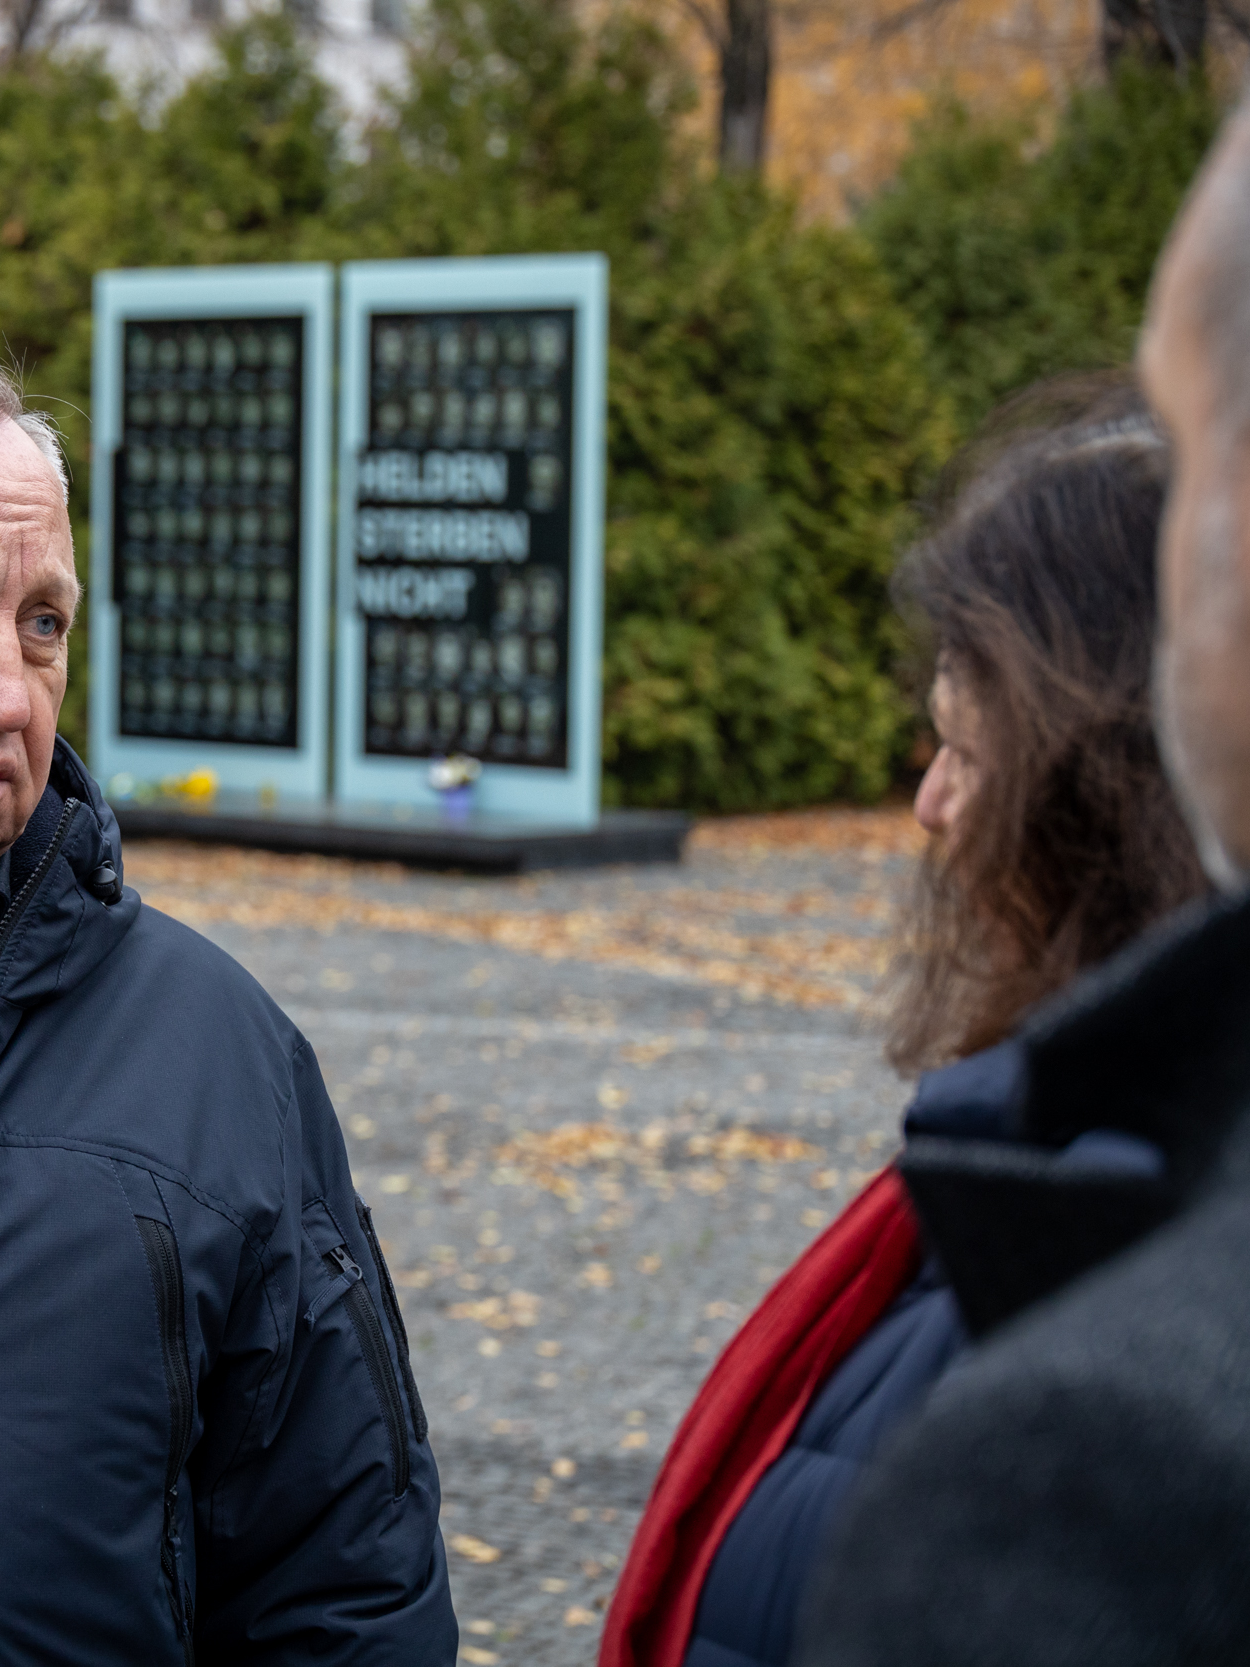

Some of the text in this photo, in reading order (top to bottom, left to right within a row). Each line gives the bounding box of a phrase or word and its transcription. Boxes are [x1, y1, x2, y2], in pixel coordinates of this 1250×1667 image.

[358, 450, 507, 502] HELDEN
[357, 508, 529, 563] STERBEN
[356, 566, 475, 619] NICHT
